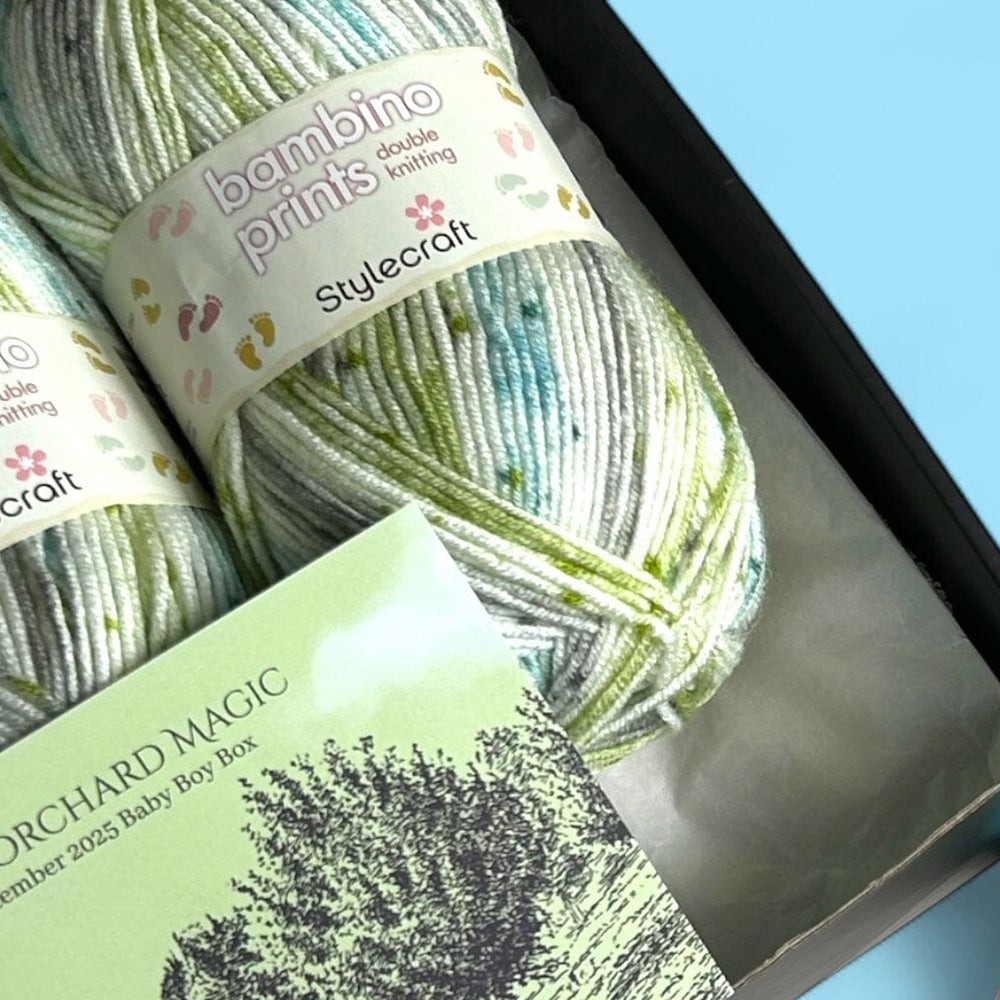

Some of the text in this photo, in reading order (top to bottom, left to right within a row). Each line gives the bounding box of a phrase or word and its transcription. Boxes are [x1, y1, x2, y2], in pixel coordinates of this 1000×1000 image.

[203, 82, 443, 217] bambino
[376, 127, 439, 160] double
[385, 147, 457, 180] knitting
[236, 160, 379, 276] prints
[315, 219, 478, 313] Stylecraft
[0, 380, 38, 401] uble
[0, 400, 58, 427] nitting
[0, 469, 82, 517] craft
[160, 667, 289, 756] MAGIC
[67, 821, 120, 861] 2025
[117, 787, 173, 829] Baby
[172, 761, 215, 794] Boy
[214, 736, 258, 768] Box
